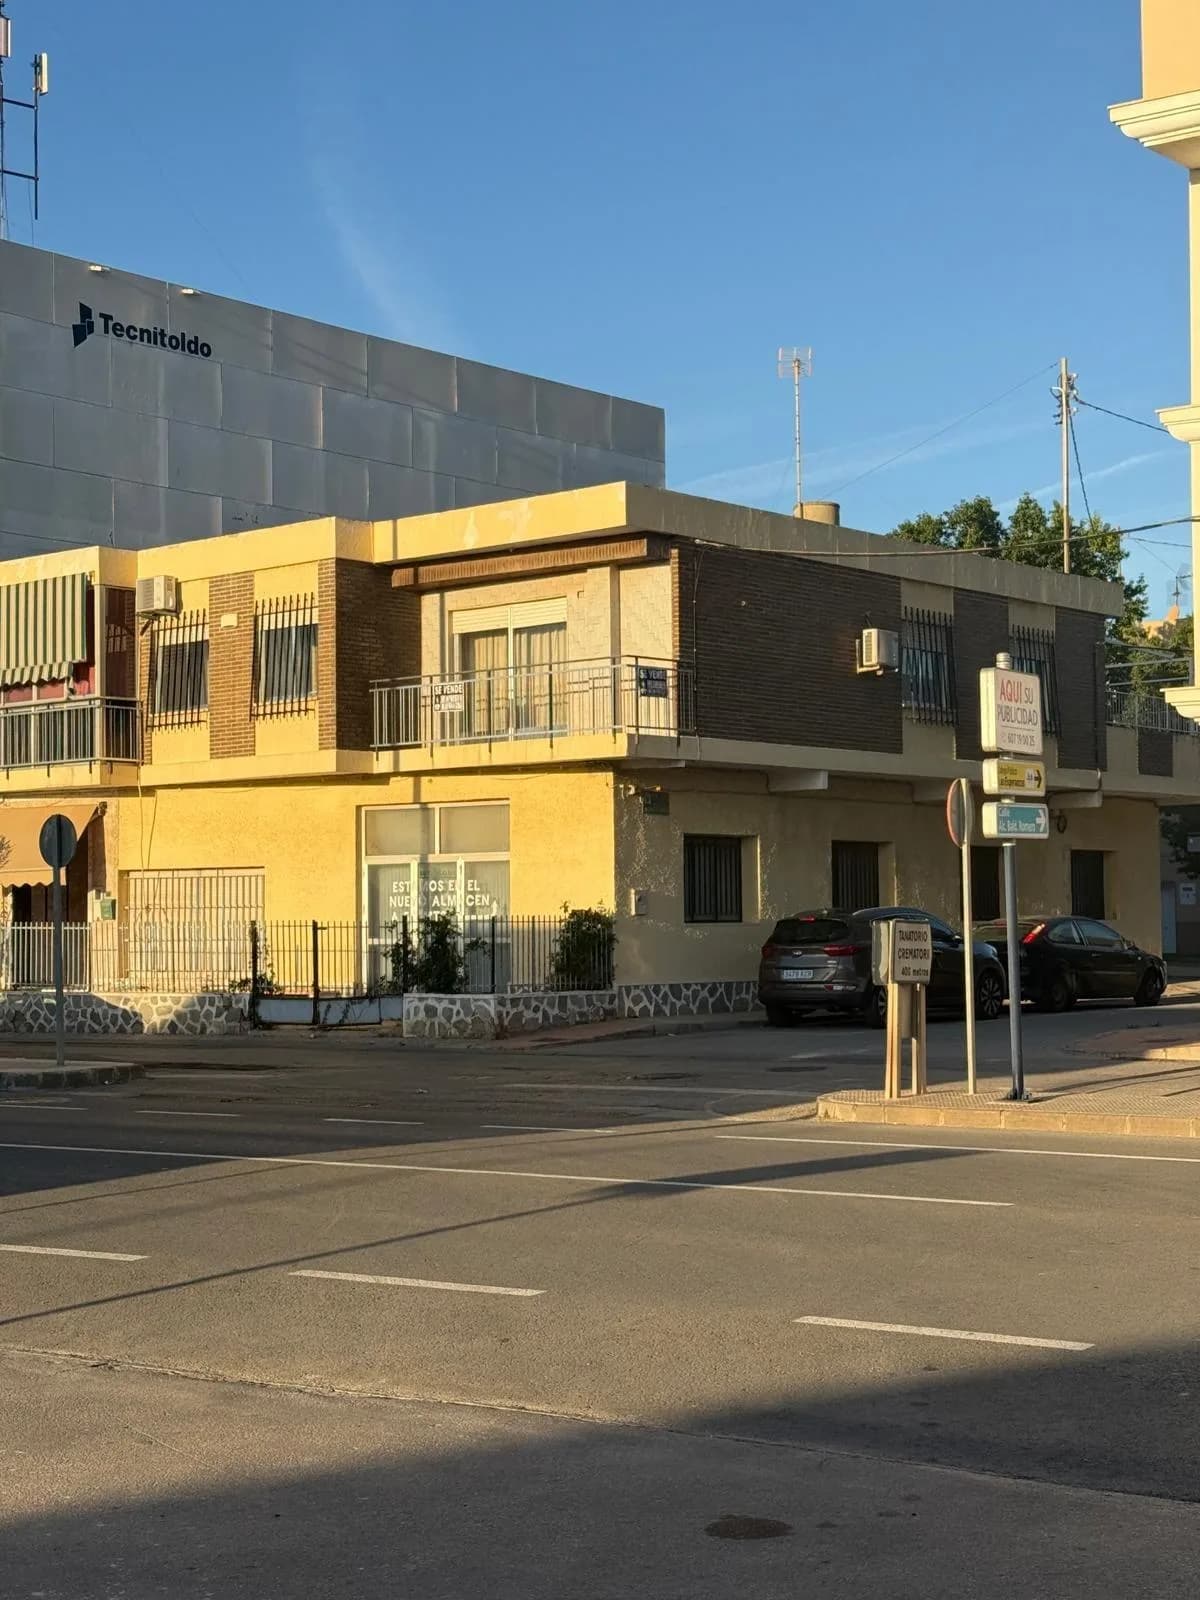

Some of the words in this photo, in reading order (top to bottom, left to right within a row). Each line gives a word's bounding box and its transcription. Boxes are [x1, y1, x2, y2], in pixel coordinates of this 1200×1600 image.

[98, 312, 212, 358] Tecnitoldo
[1024, 687, 1034, 705] SU
[996, 703, 1039, 726] PUBLICIDAD
[392, 880, 444, 893] ESTMOS
[467, 879, 480, 892] EL
[389, 895, 427, 907] NUEO
[432, 894, 490, 908] ALMCEN
[898, 929, 928, 942] TANATORIO
[897, 947, 931, 960] CREMATORI
